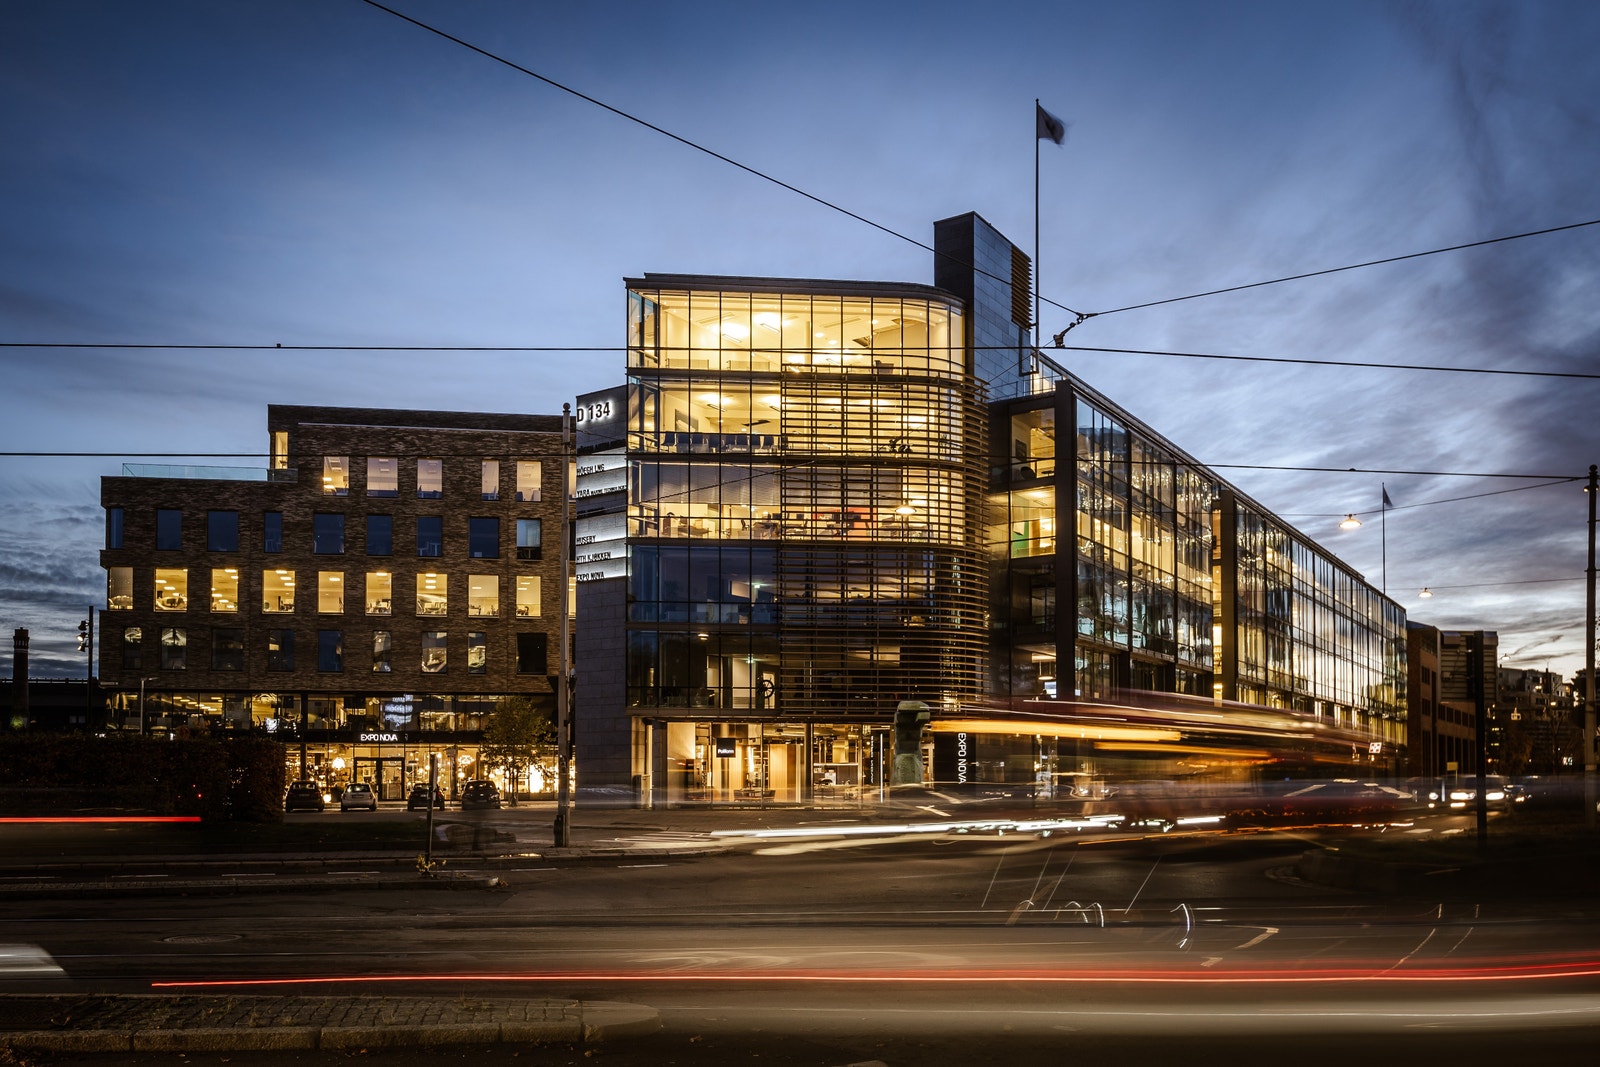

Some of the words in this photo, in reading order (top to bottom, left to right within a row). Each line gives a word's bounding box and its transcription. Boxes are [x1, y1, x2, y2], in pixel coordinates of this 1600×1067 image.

[577, 408, 585, 422] D
[588, 402, 610, 419] 134
[577, 573, 590, 581] EXPO
[591, 571, 605, 580] NOVA
[361, 733, 379, 741] EXPO
[380, 733, 398, 741] NOVA
[958, 732, 967, 757] EXPO
[958, 759, 967, 784] NOVA
